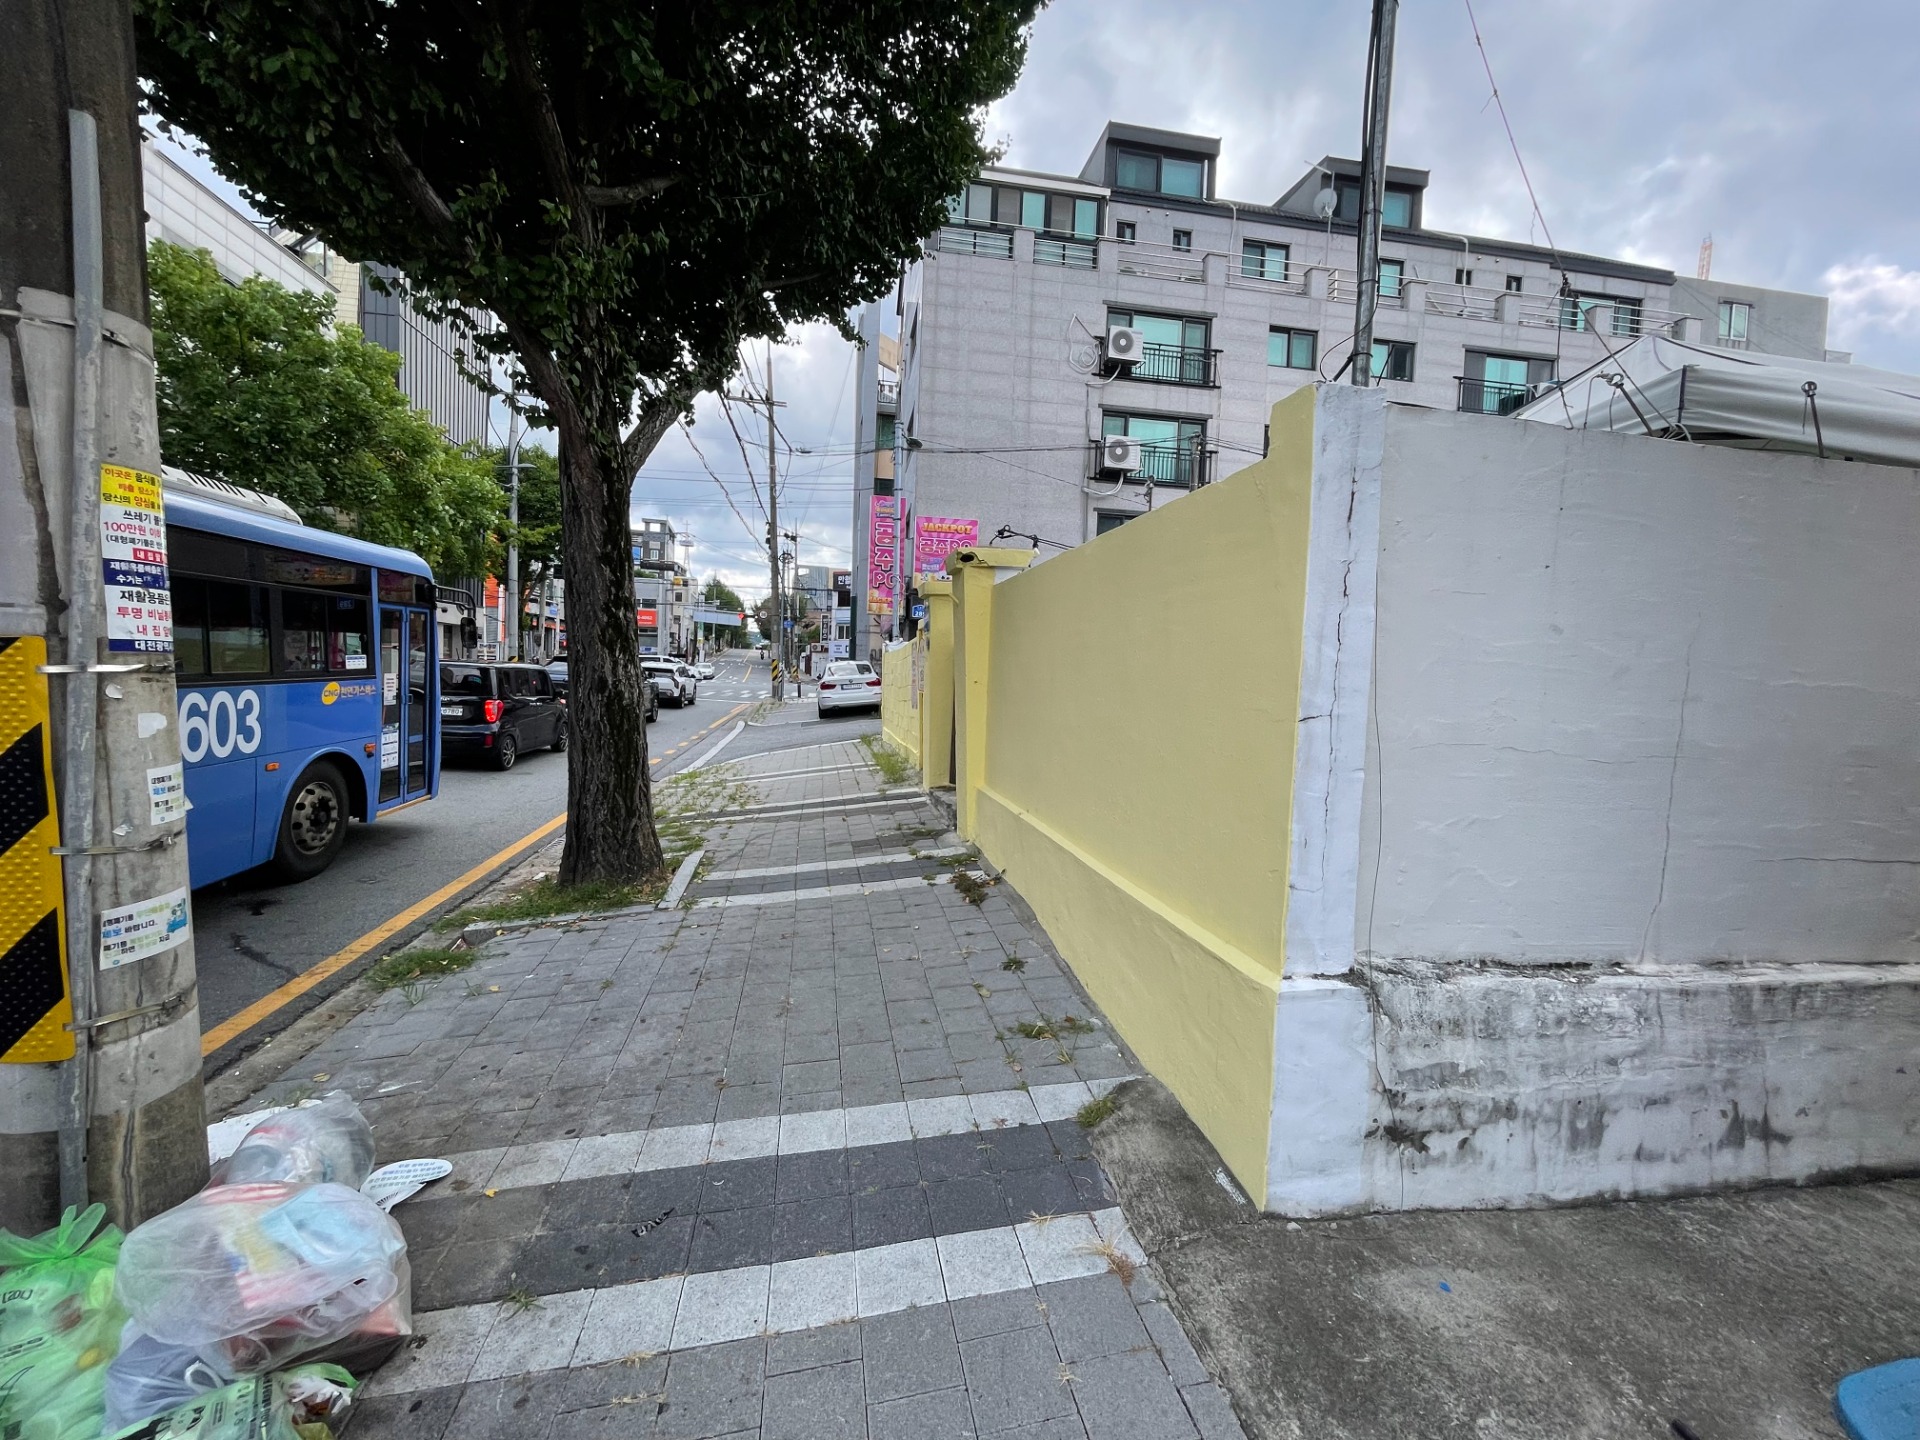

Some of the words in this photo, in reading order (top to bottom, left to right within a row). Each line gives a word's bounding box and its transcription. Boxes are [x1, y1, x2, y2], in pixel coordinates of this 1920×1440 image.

[104, 467, 132, 480] 이곳은
[102, 492, 132, 504] 당신의
[123, 509, 152, 525] 쓰레기
[103, 521, 146, 537] 100만원
[922, 522, 973, 534] JACKPOT
[116, 574, 144, 586] 수거는
[116, 606, 143, 620] 투명
[136, 624, 148, 636] 내
[152, 625, 161, 637] 집
[178, 689, 262, 763] 603
